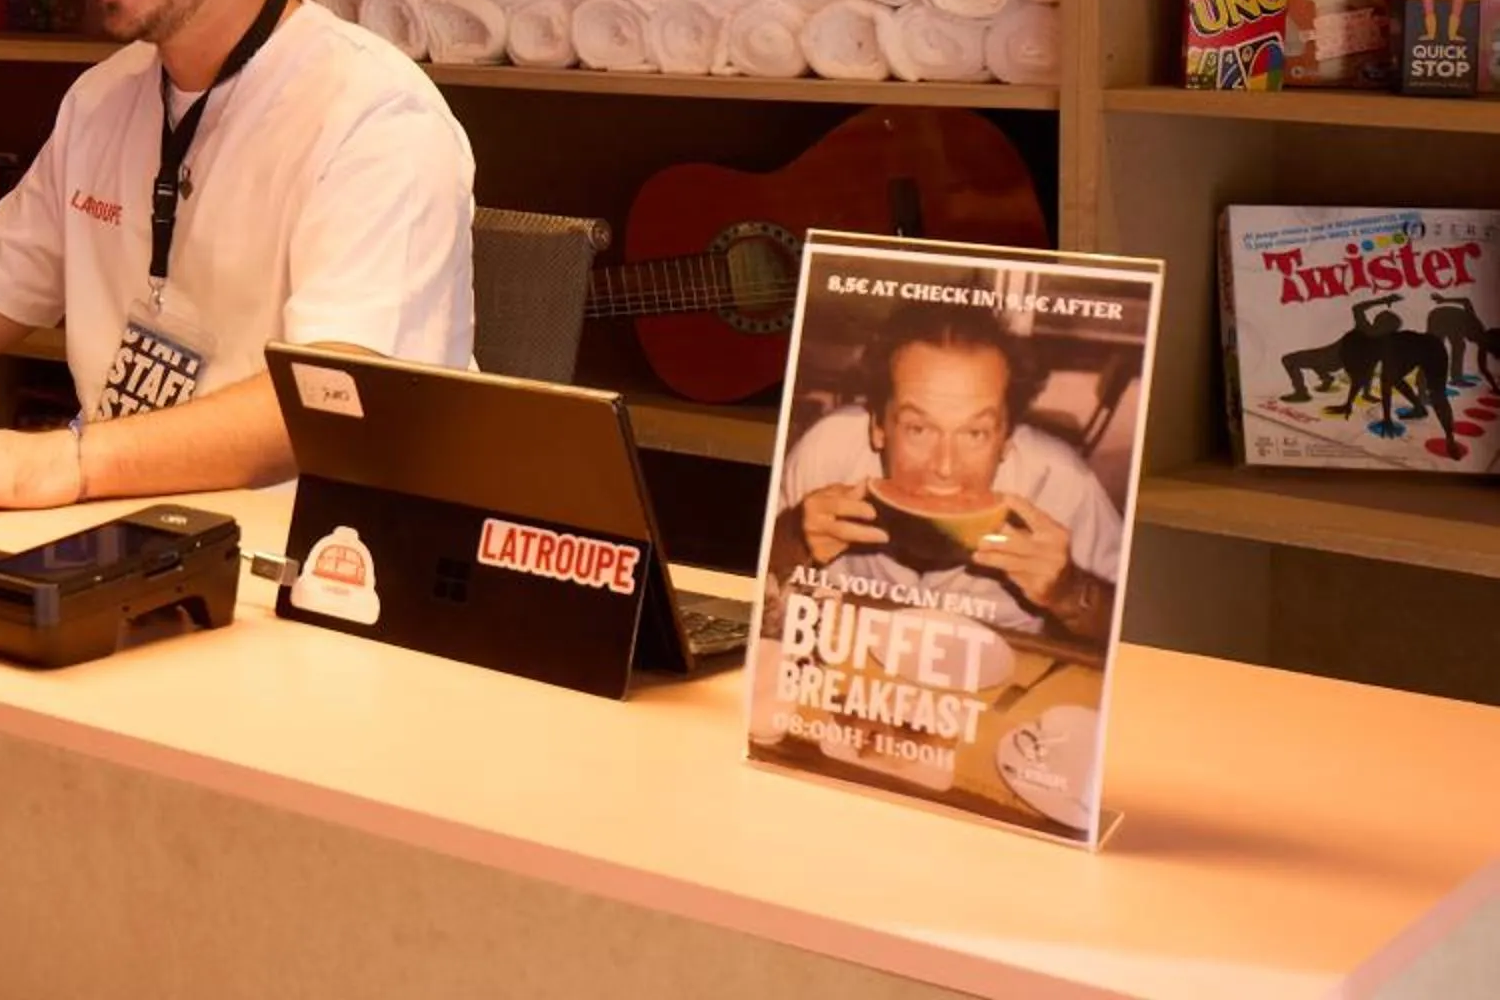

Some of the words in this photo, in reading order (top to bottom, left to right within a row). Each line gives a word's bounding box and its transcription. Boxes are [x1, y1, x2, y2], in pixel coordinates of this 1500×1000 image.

[1411, 60, 1471, 79] STOP
[1413, 44, 1468, 60] QUICK
[827, 274, 868, 296] 8,5€
[871, 280, 899, 298] AT
[900, 282, 969, 306] CHECK
[972, 288, 997, 308] IN
[1052, 296, 1123, 320] AFTER
[1263, 242, 1482, 305] Twister
[480, 522, 640, 590] LATROUPE
[790, 565, 834, 591] ALL
[839, 575, 887, 599] YOU
[890, 584, 941, 608] CAN
[944, 592, 998, 621] EAT!
[782, 594, 996, 694] BUFFET
[778, 660, 987, 745] BREAKFAST
